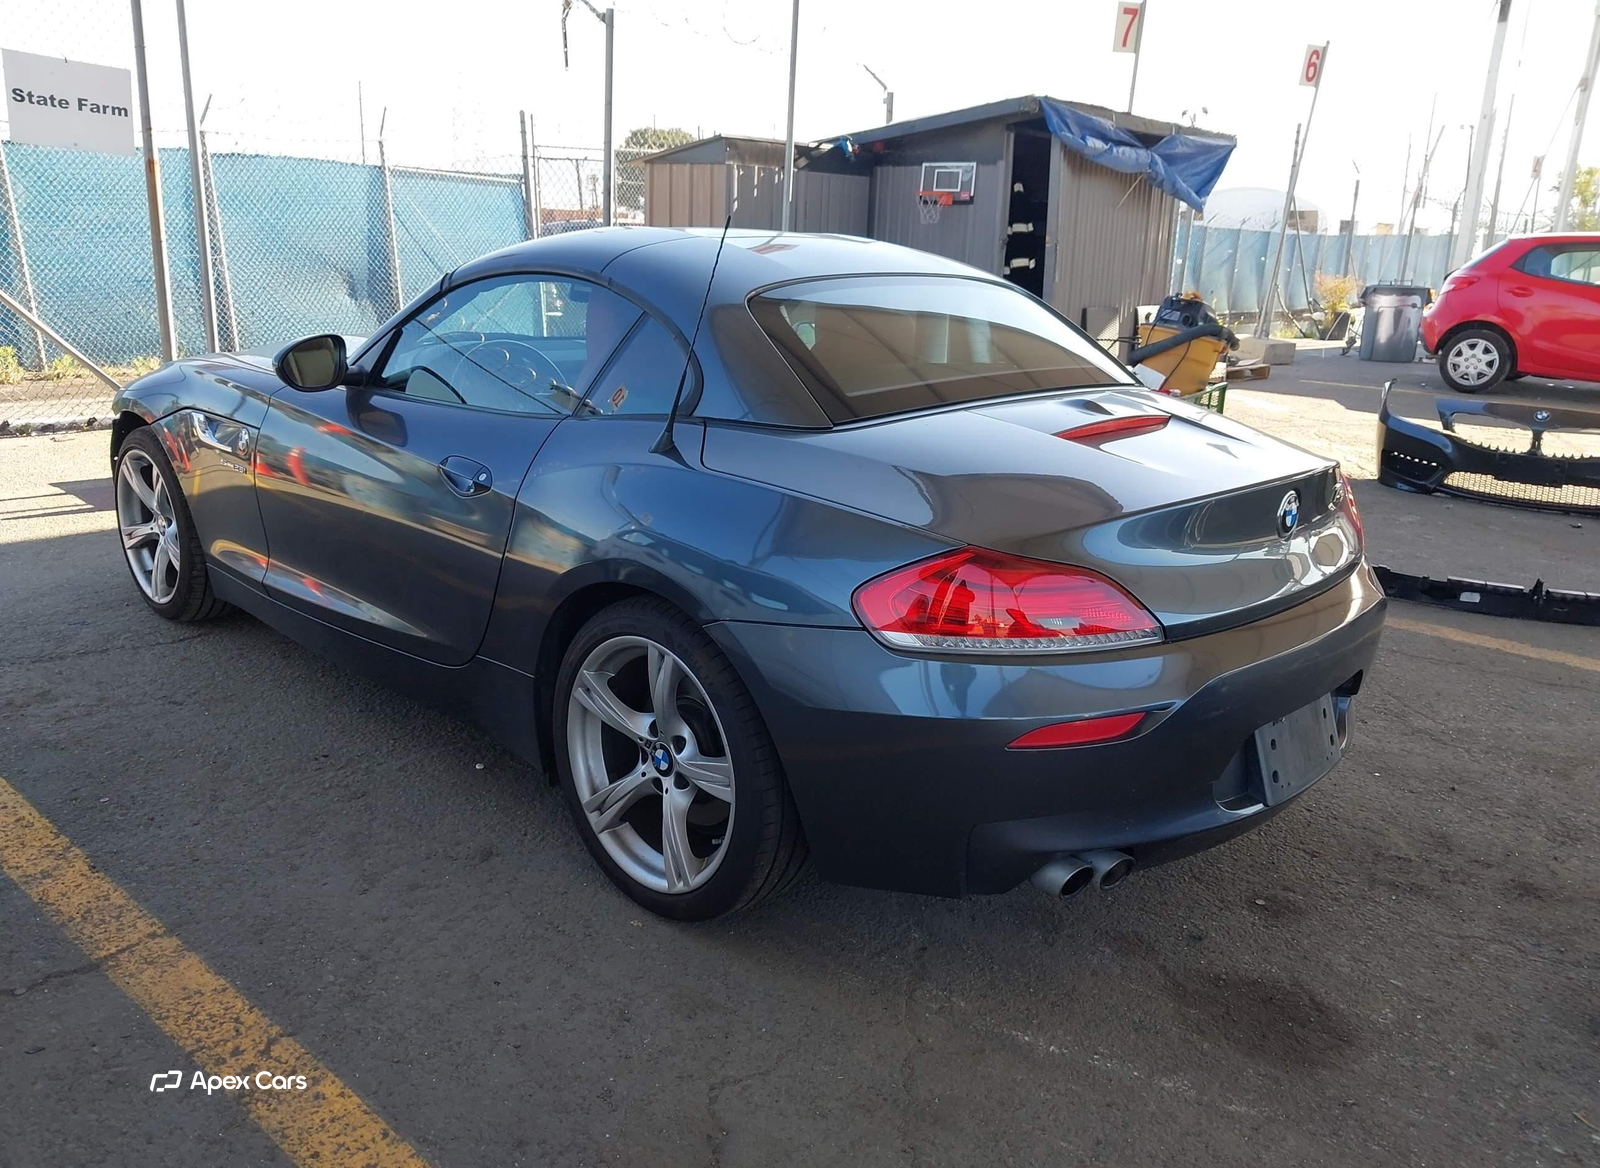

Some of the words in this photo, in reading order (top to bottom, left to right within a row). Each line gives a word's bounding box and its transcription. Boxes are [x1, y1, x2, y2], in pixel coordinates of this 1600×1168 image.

[1122, 7, 1139, 48] 7
[1305, 49, 1320, 83] 6
[11, 87, 70, 109] State
[77, 97, 128, 117] Farm
